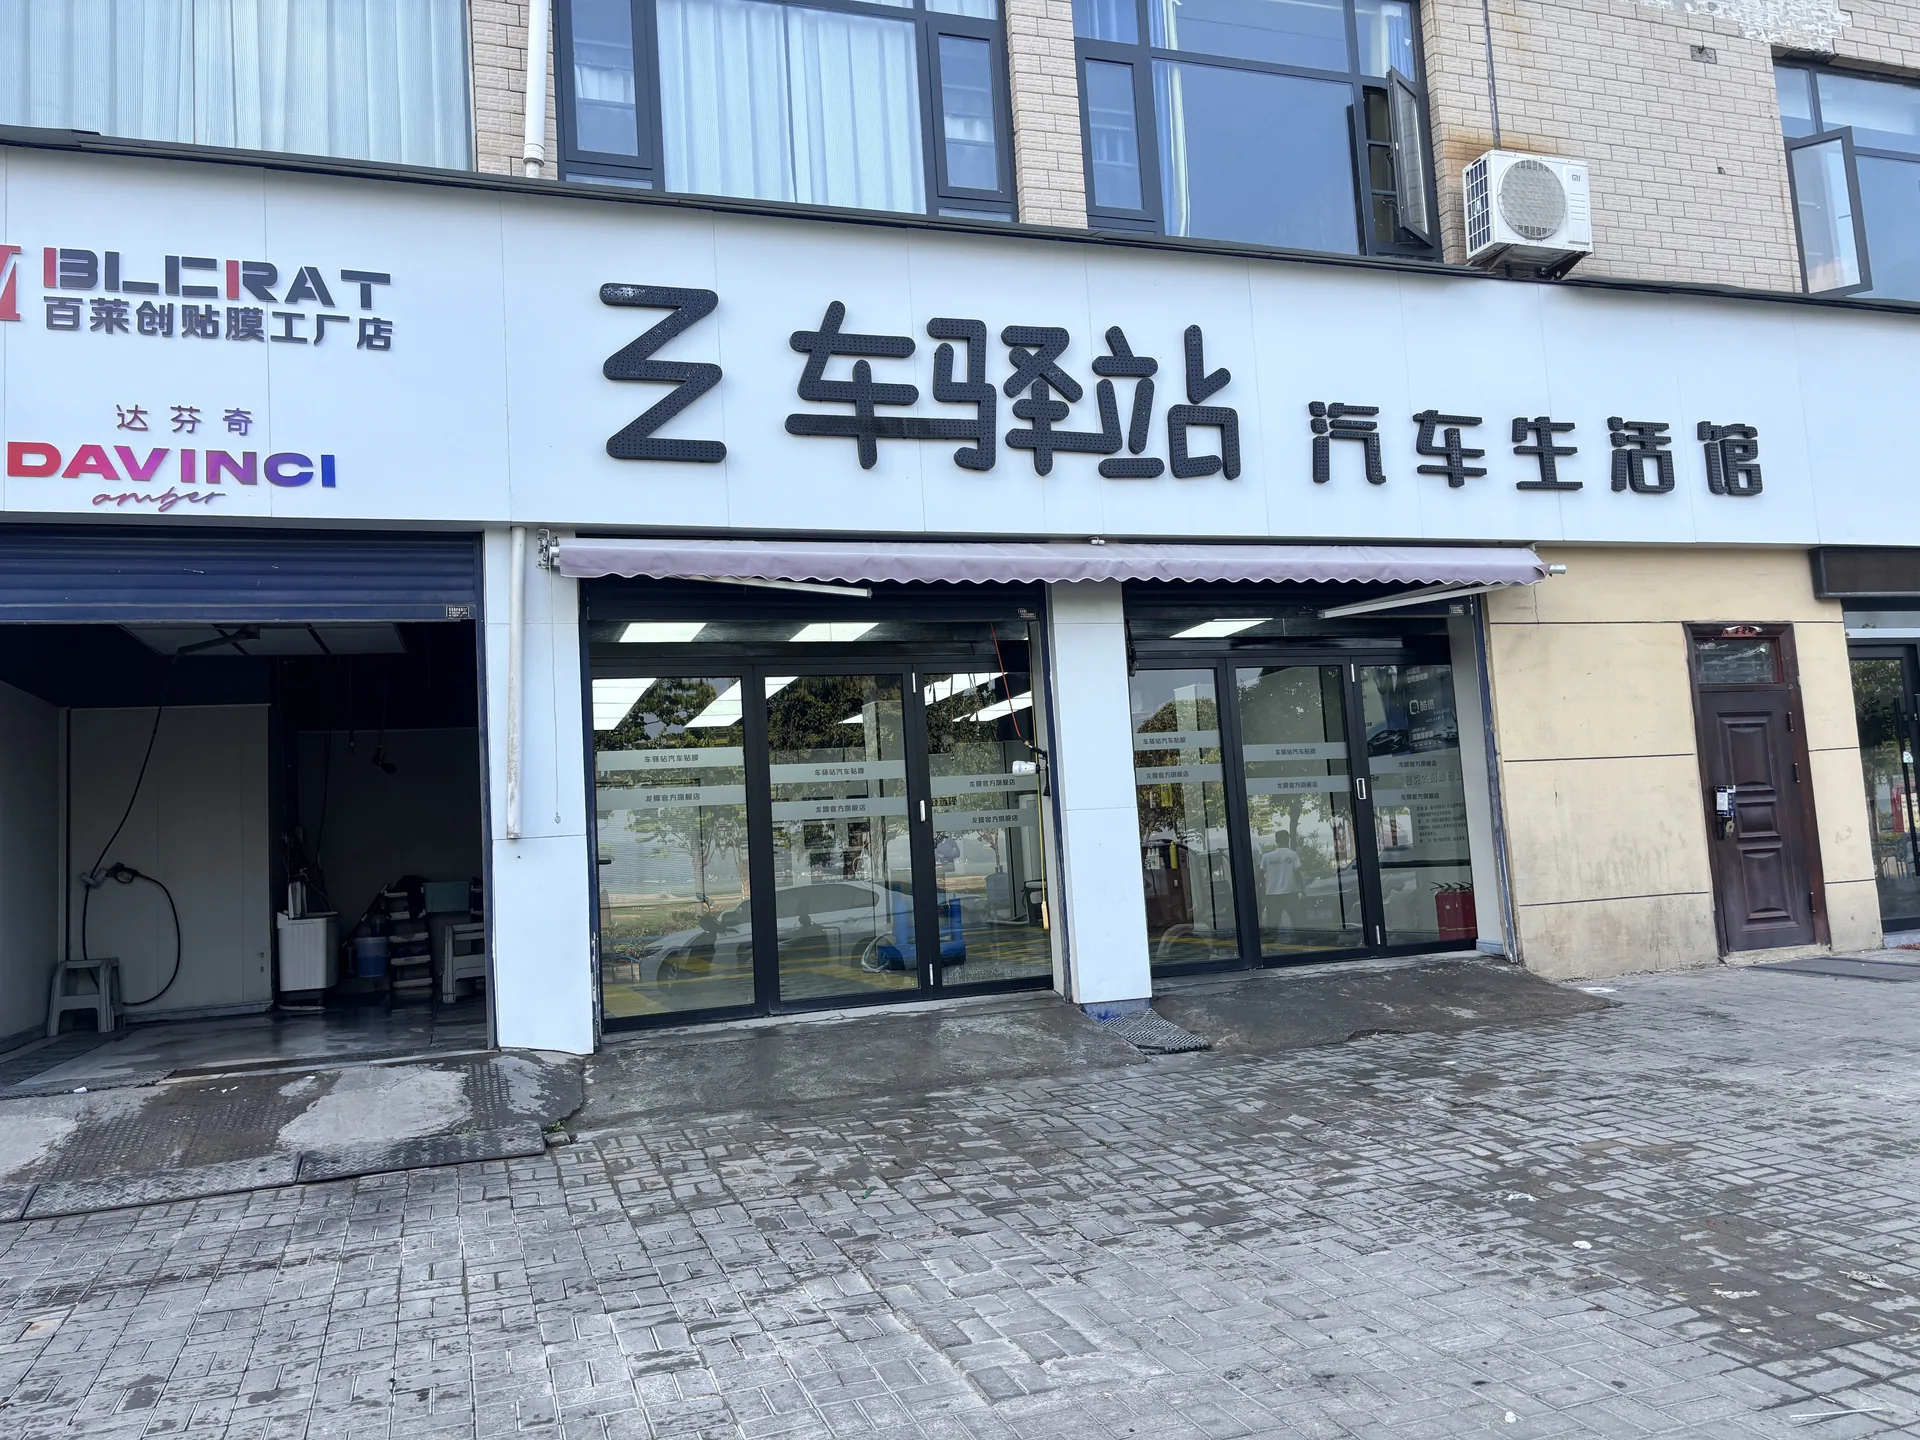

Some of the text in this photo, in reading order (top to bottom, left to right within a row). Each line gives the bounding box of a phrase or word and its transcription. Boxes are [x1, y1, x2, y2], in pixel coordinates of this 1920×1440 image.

[43, 295, 394, 352] 百莱创贴膜工厂店
[116, 404, 254, 436] 达芬奇
[1308, 400, 1764, 496] 汽车生活馆
[7, 441, 338, 489] DAVINCI
[644, 754, 699, 763] 车驿站汽车贴膜
[814, 767, 865, 776] 车驿站汽车贴膜
[969, 779, 1016, 788] 龙膜官方旗舰店
[645, 793, 701, 802] 龙膜官方旗舰店
[815, 804, 866, 813] 龙膜官方旗舰店
[972, 814, 1019, 823] 龙膜官方旗舰店
